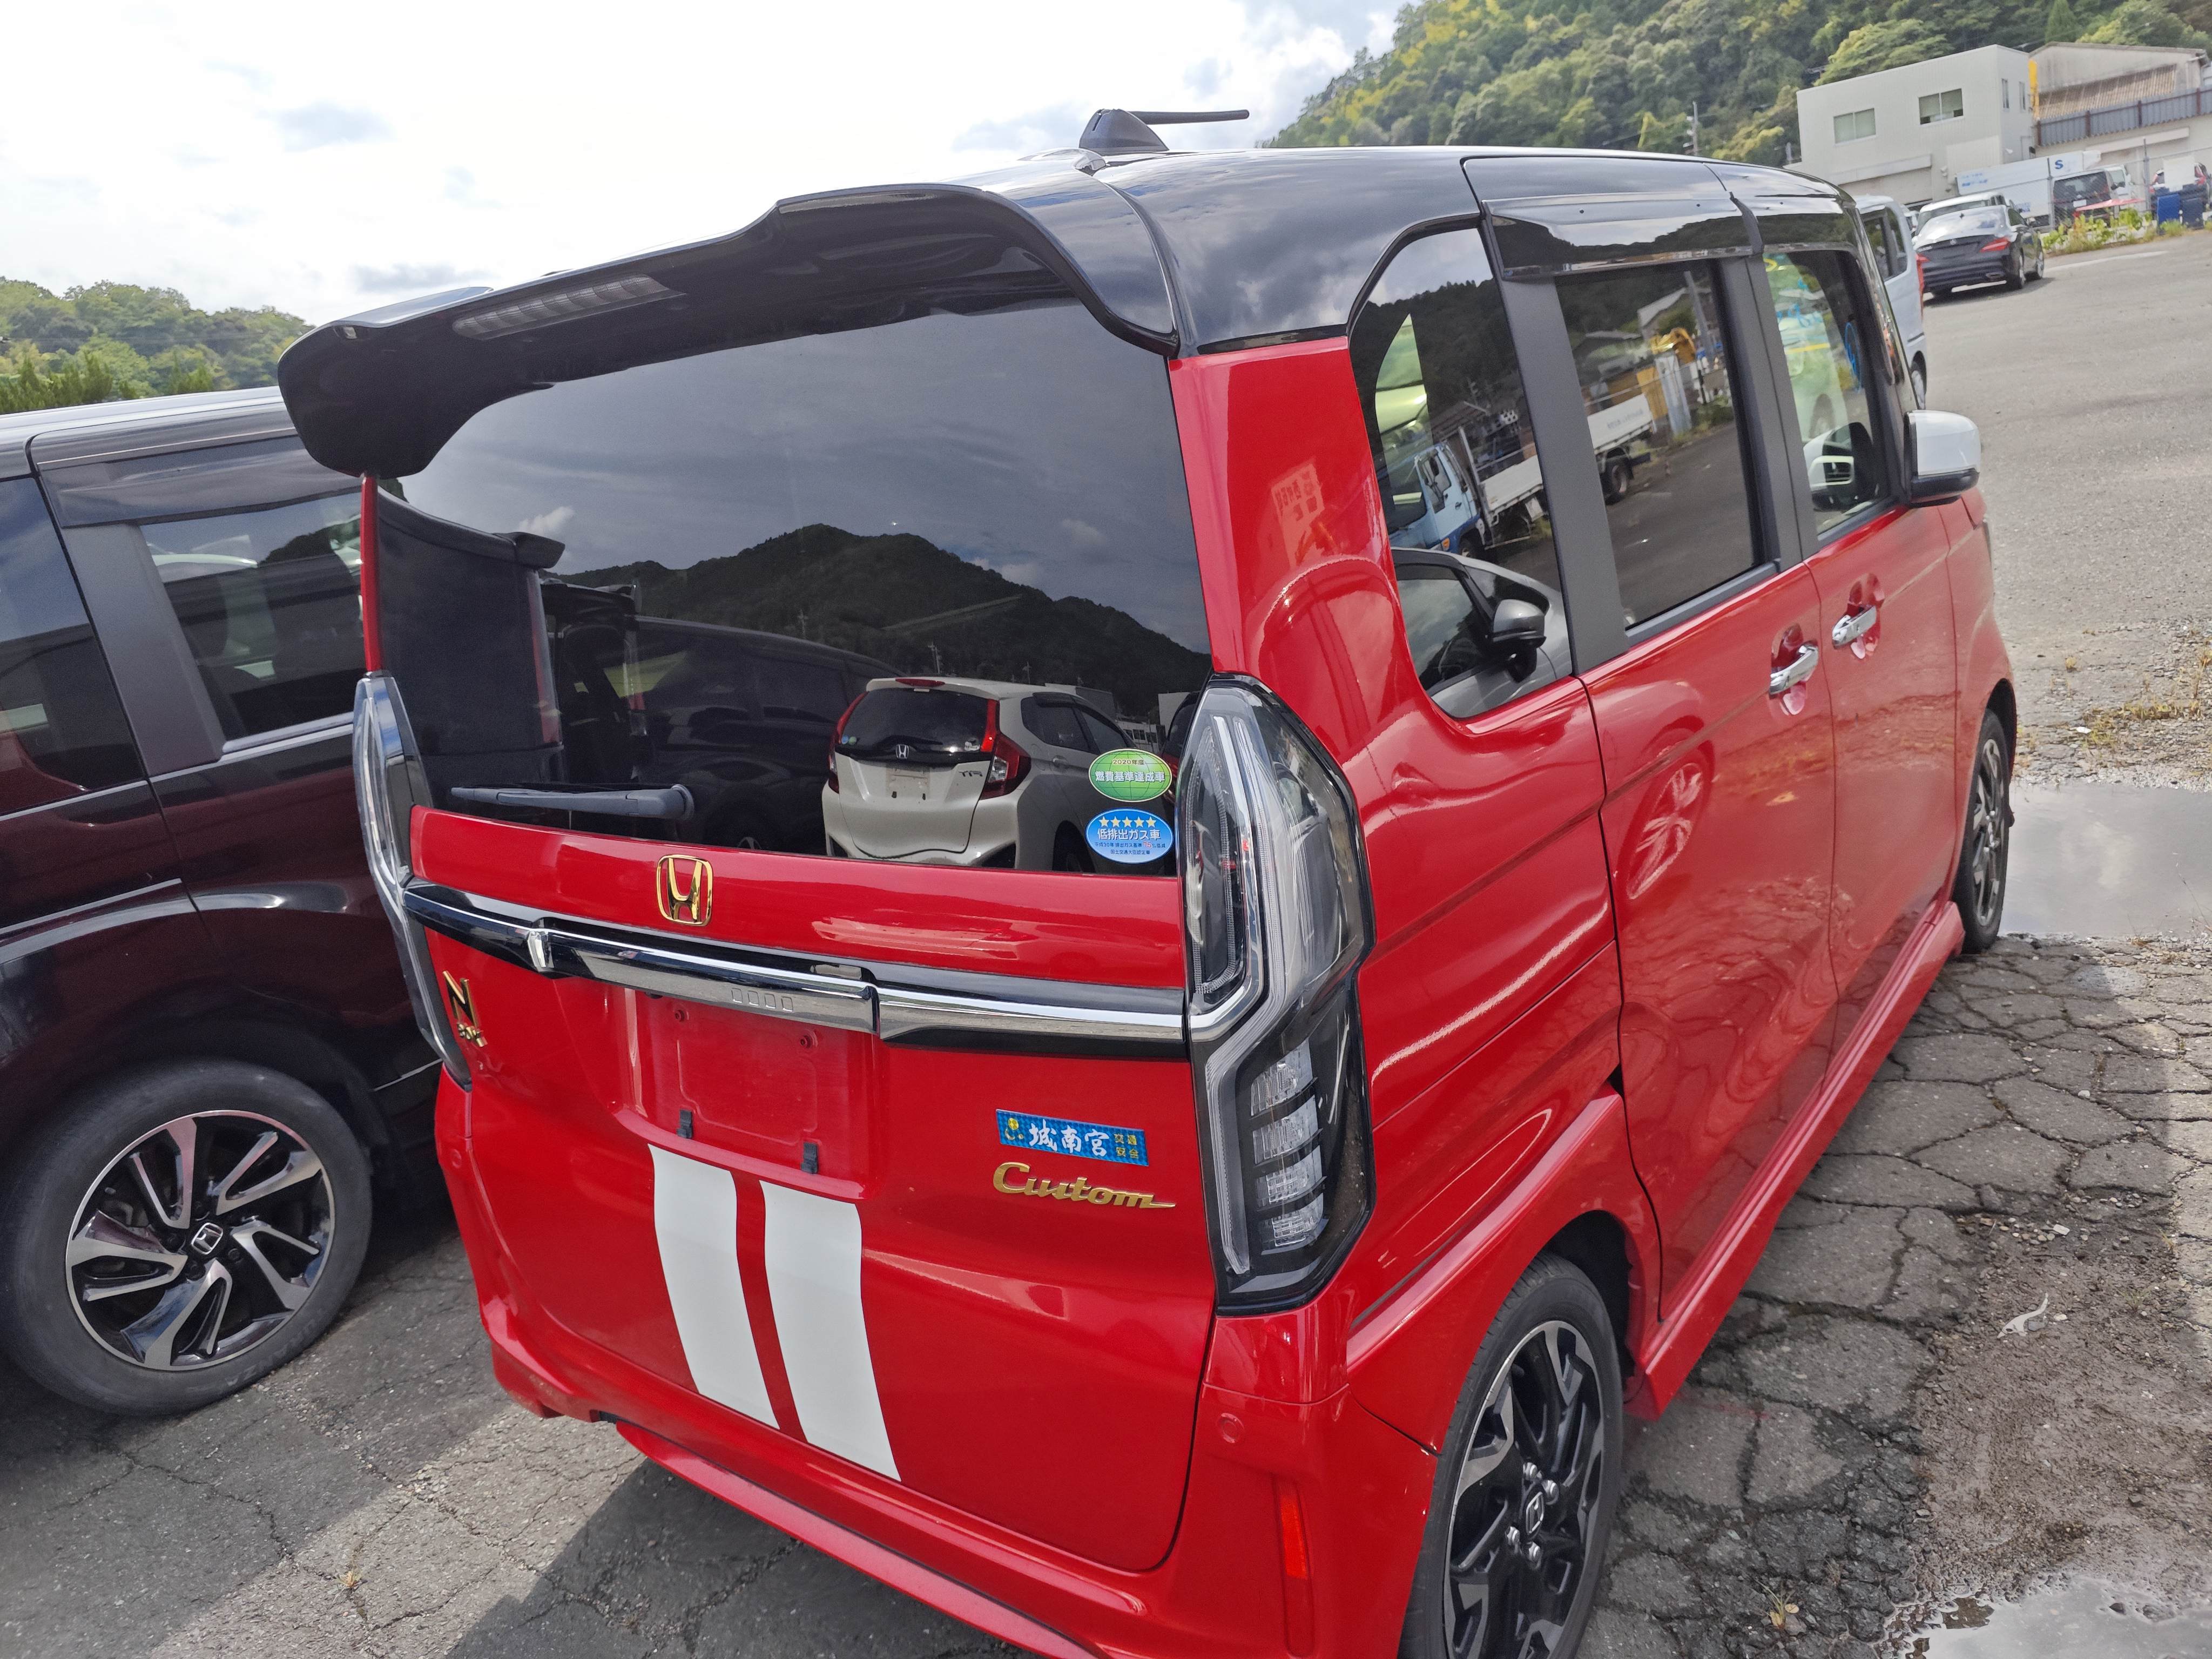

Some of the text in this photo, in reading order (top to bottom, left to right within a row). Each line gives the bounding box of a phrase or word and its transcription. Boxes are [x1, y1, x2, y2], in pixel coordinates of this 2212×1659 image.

[2054, 160, 2064, 170] S
[1095, 771, 1166, 783] 燃費基準達成車
[1097, 828, 1161, 841] 低排出ガス車
[1028, 1119, 1110, 1157] 城南宮
[1114, 1134, 1137, 1145] 交通
[1116, 1147, 1139, 1159] 安全
[993, 1162, 1176, 1209] Custom
